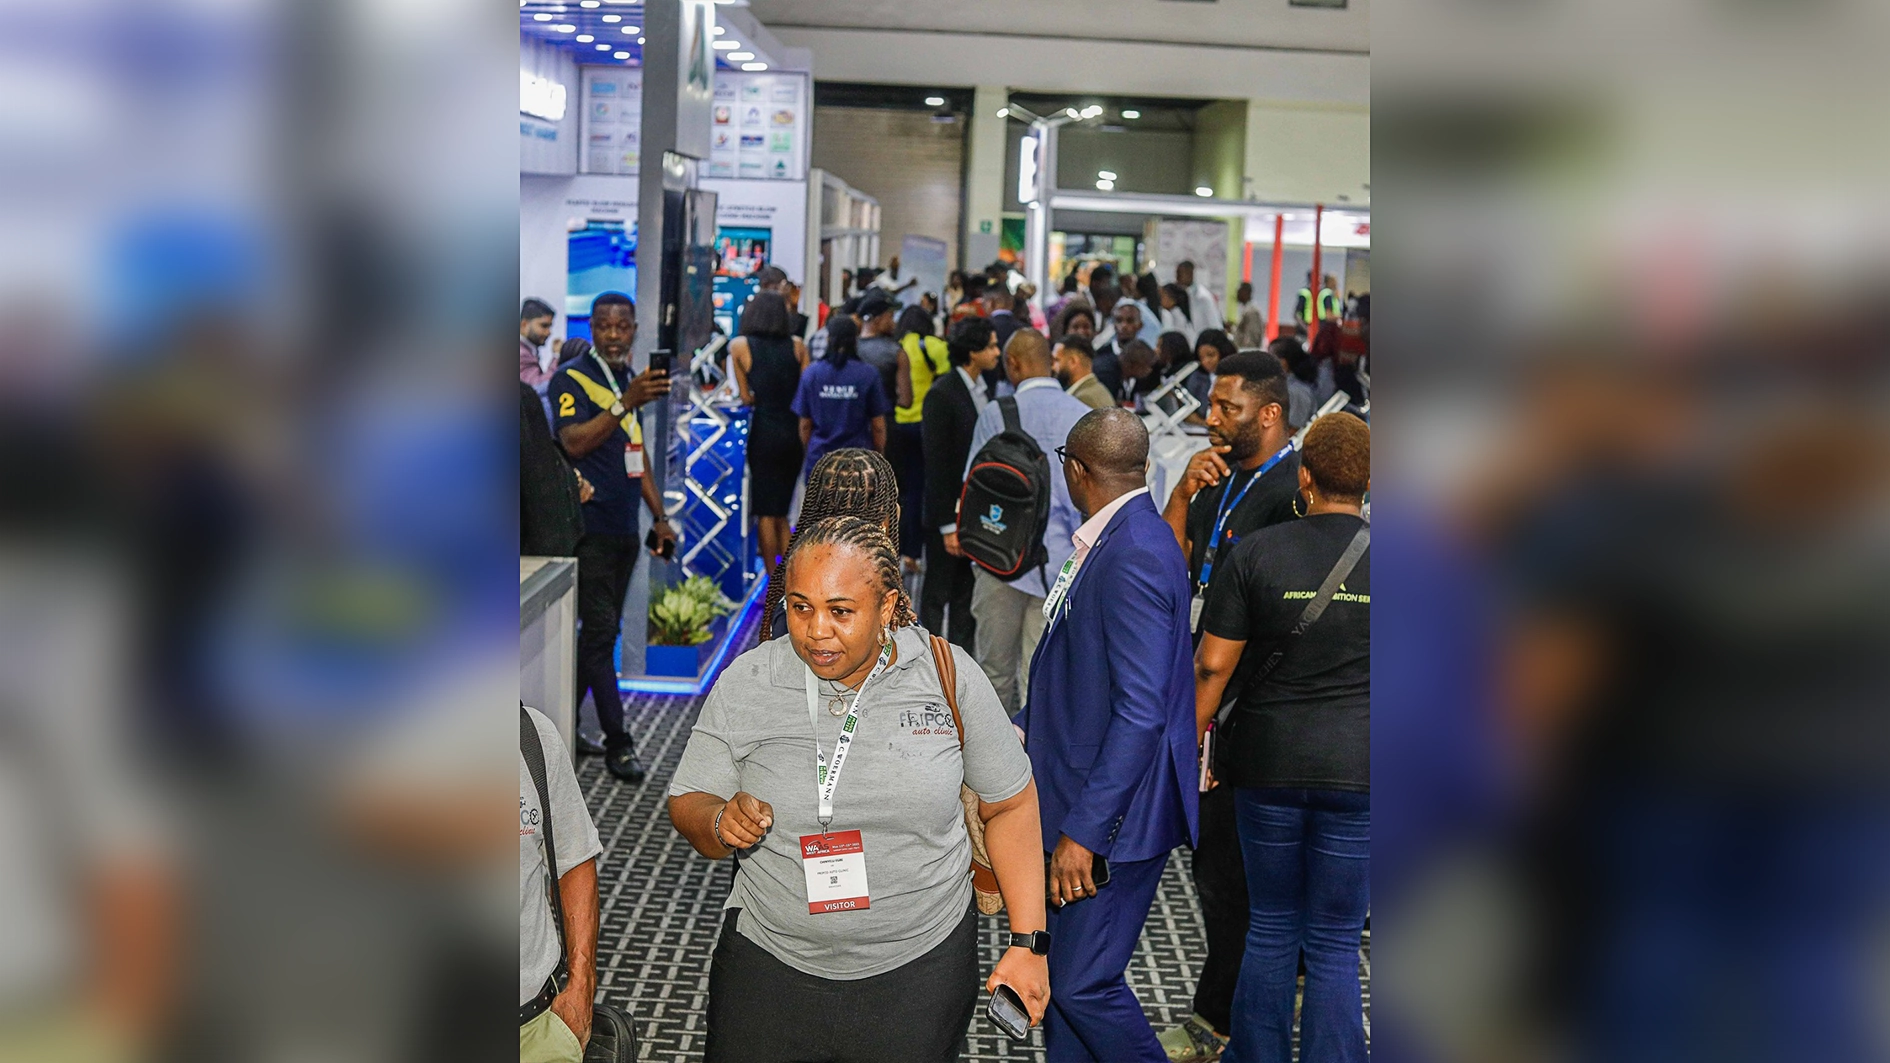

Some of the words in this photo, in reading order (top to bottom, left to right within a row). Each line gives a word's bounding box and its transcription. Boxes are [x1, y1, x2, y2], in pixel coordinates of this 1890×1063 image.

[559, 392, 576, 417] 2
[912, 727, 931, 736] auto
[824, 900, 856, 911] VISITOR
